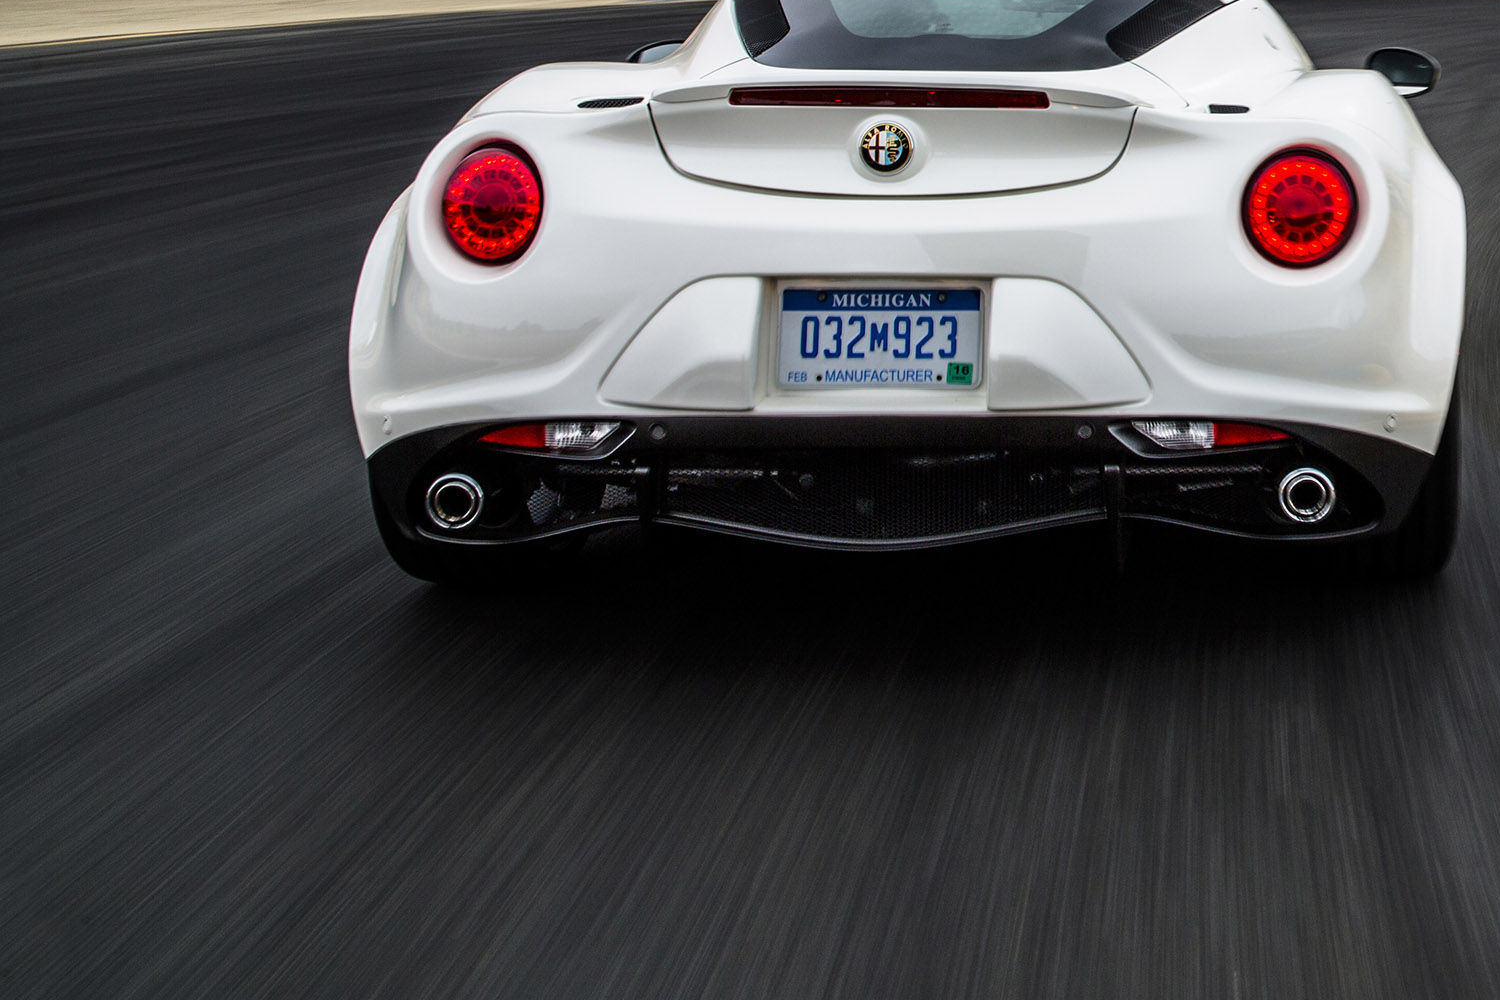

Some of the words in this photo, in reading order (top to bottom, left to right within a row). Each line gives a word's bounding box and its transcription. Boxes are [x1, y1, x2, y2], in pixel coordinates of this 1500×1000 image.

[862, 127, 880, 148] ALFA
[832, 293, 932, 307] MICHIGAN
[800, 315, 958, 359] 032M923
[787, 371, 808, 382] FEB
[824, 369, 933, 382] MANUFACTURER
[953, 365, 970, 375] 16
